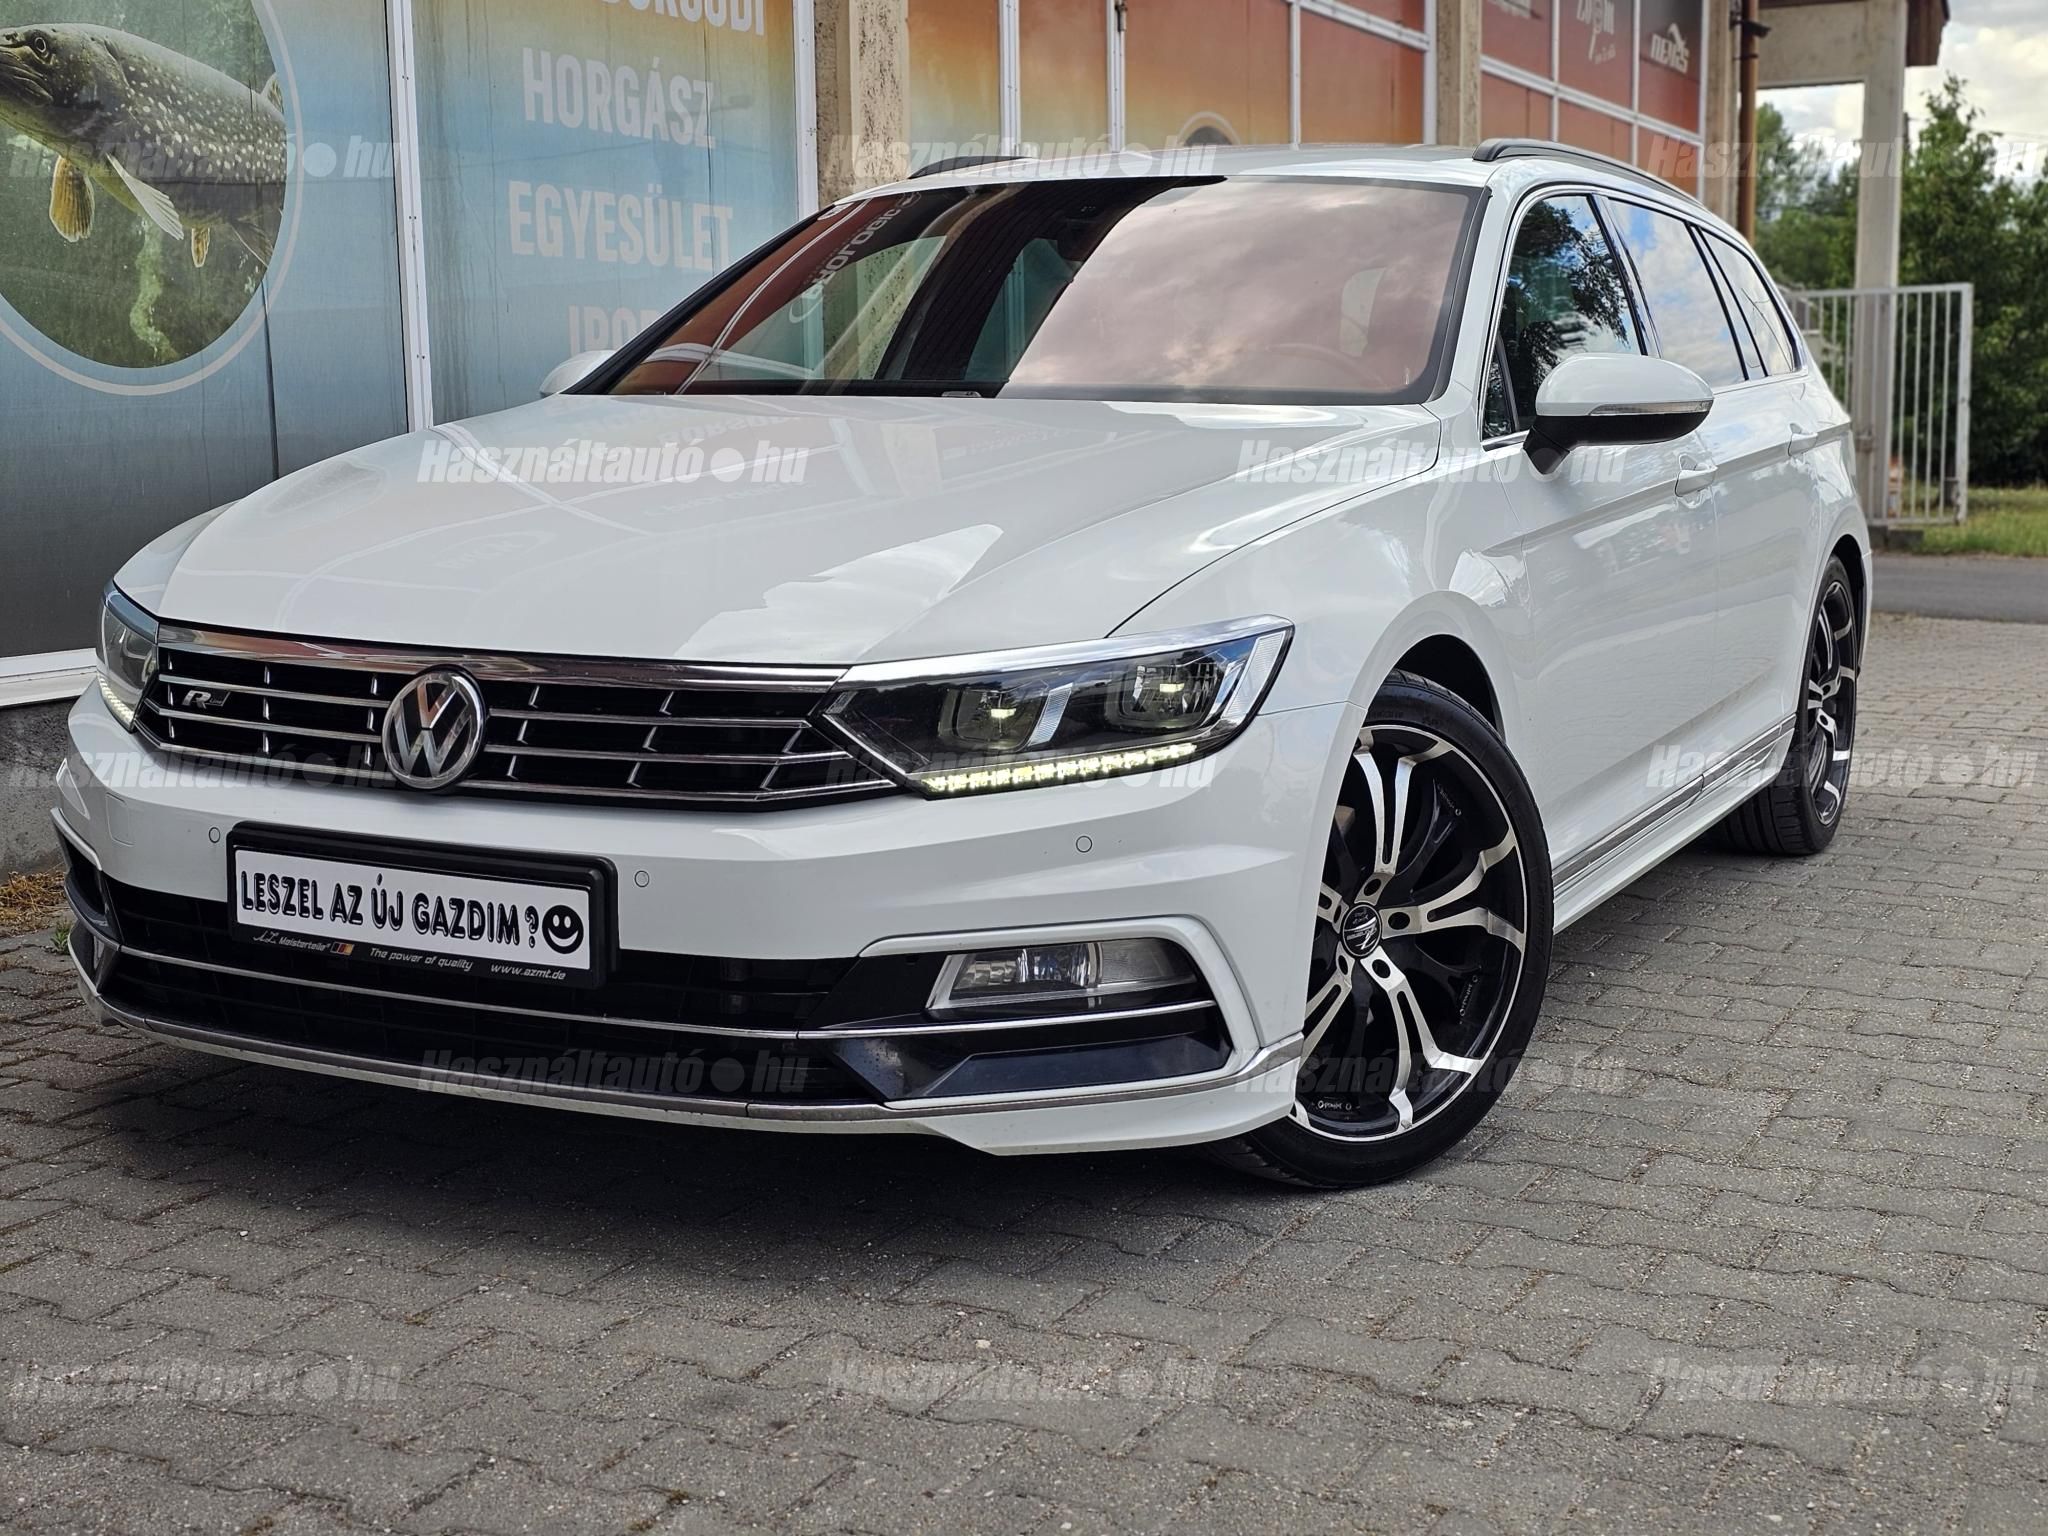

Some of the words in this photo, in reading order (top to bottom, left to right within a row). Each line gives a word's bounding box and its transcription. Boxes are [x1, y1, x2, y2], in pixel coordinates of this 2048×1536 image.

[523, 48, 716, 149] HORGÁSZ
[508, 180, 734, 273] EGYESÜLET
[241, 871, 324, 920] LESZEL
[330, 883, 363, 925] AZ
[371, 873, 403, 931] ÚJ
[369, 948, 387, 958] The
[388, 950, 422, 963] power
[425, 956, 437, 965] of
[438, 958, 474, 972] quality
[490, 963, 566, 980] www.azmt.de
